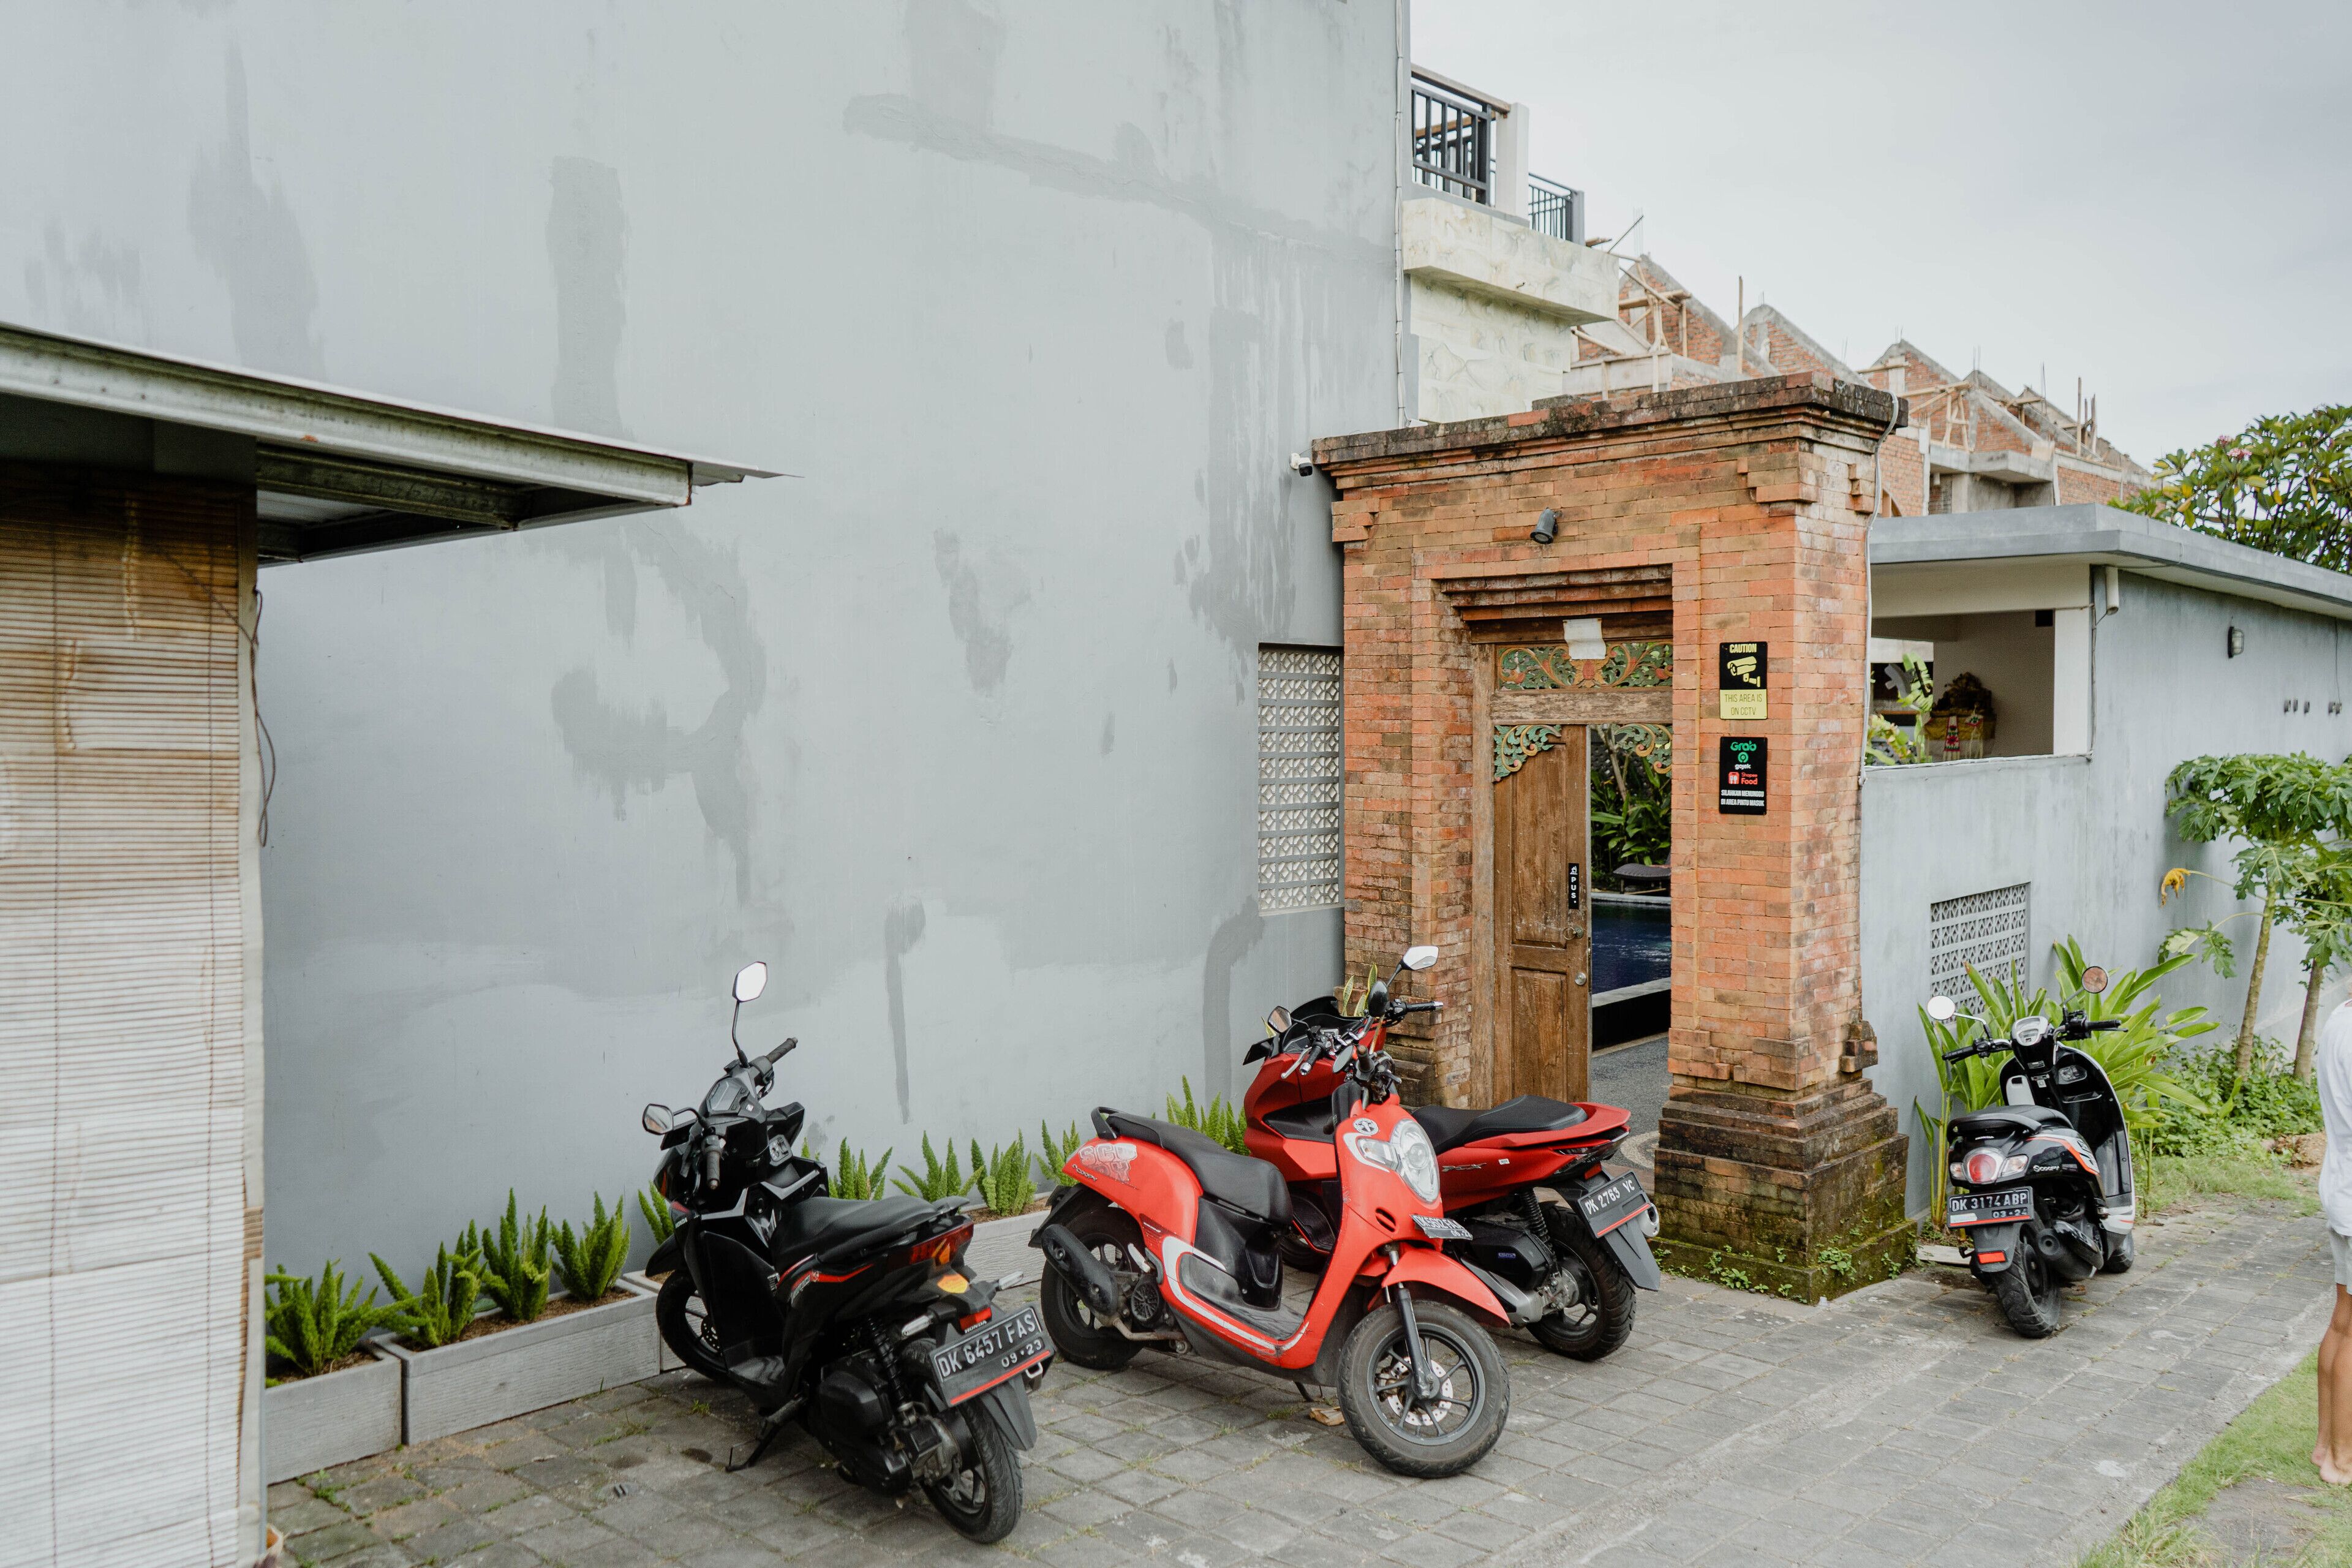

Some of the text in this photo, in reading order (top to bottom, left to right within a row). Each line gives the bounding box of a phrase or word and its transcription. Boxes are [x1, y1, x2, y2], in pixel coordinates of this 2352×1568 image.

[1729, 644, 1757, 654] CAUTION
[1725, 693, 1762, 703] THIS AREA IS
[1740, 707, 1756, 715] CCTV
[1730, 741, 1757, 751] Grab
[1585, 1199, 1599, 1215] DK
[1622, 1179, 1635, 1193] VC
[1952, 1193, 2027, 1212] DK 3174 ABP
[964, 1320, 987, 1333] HONDA
[938, 1314, 1036, 1378] DK 6457 FAS
